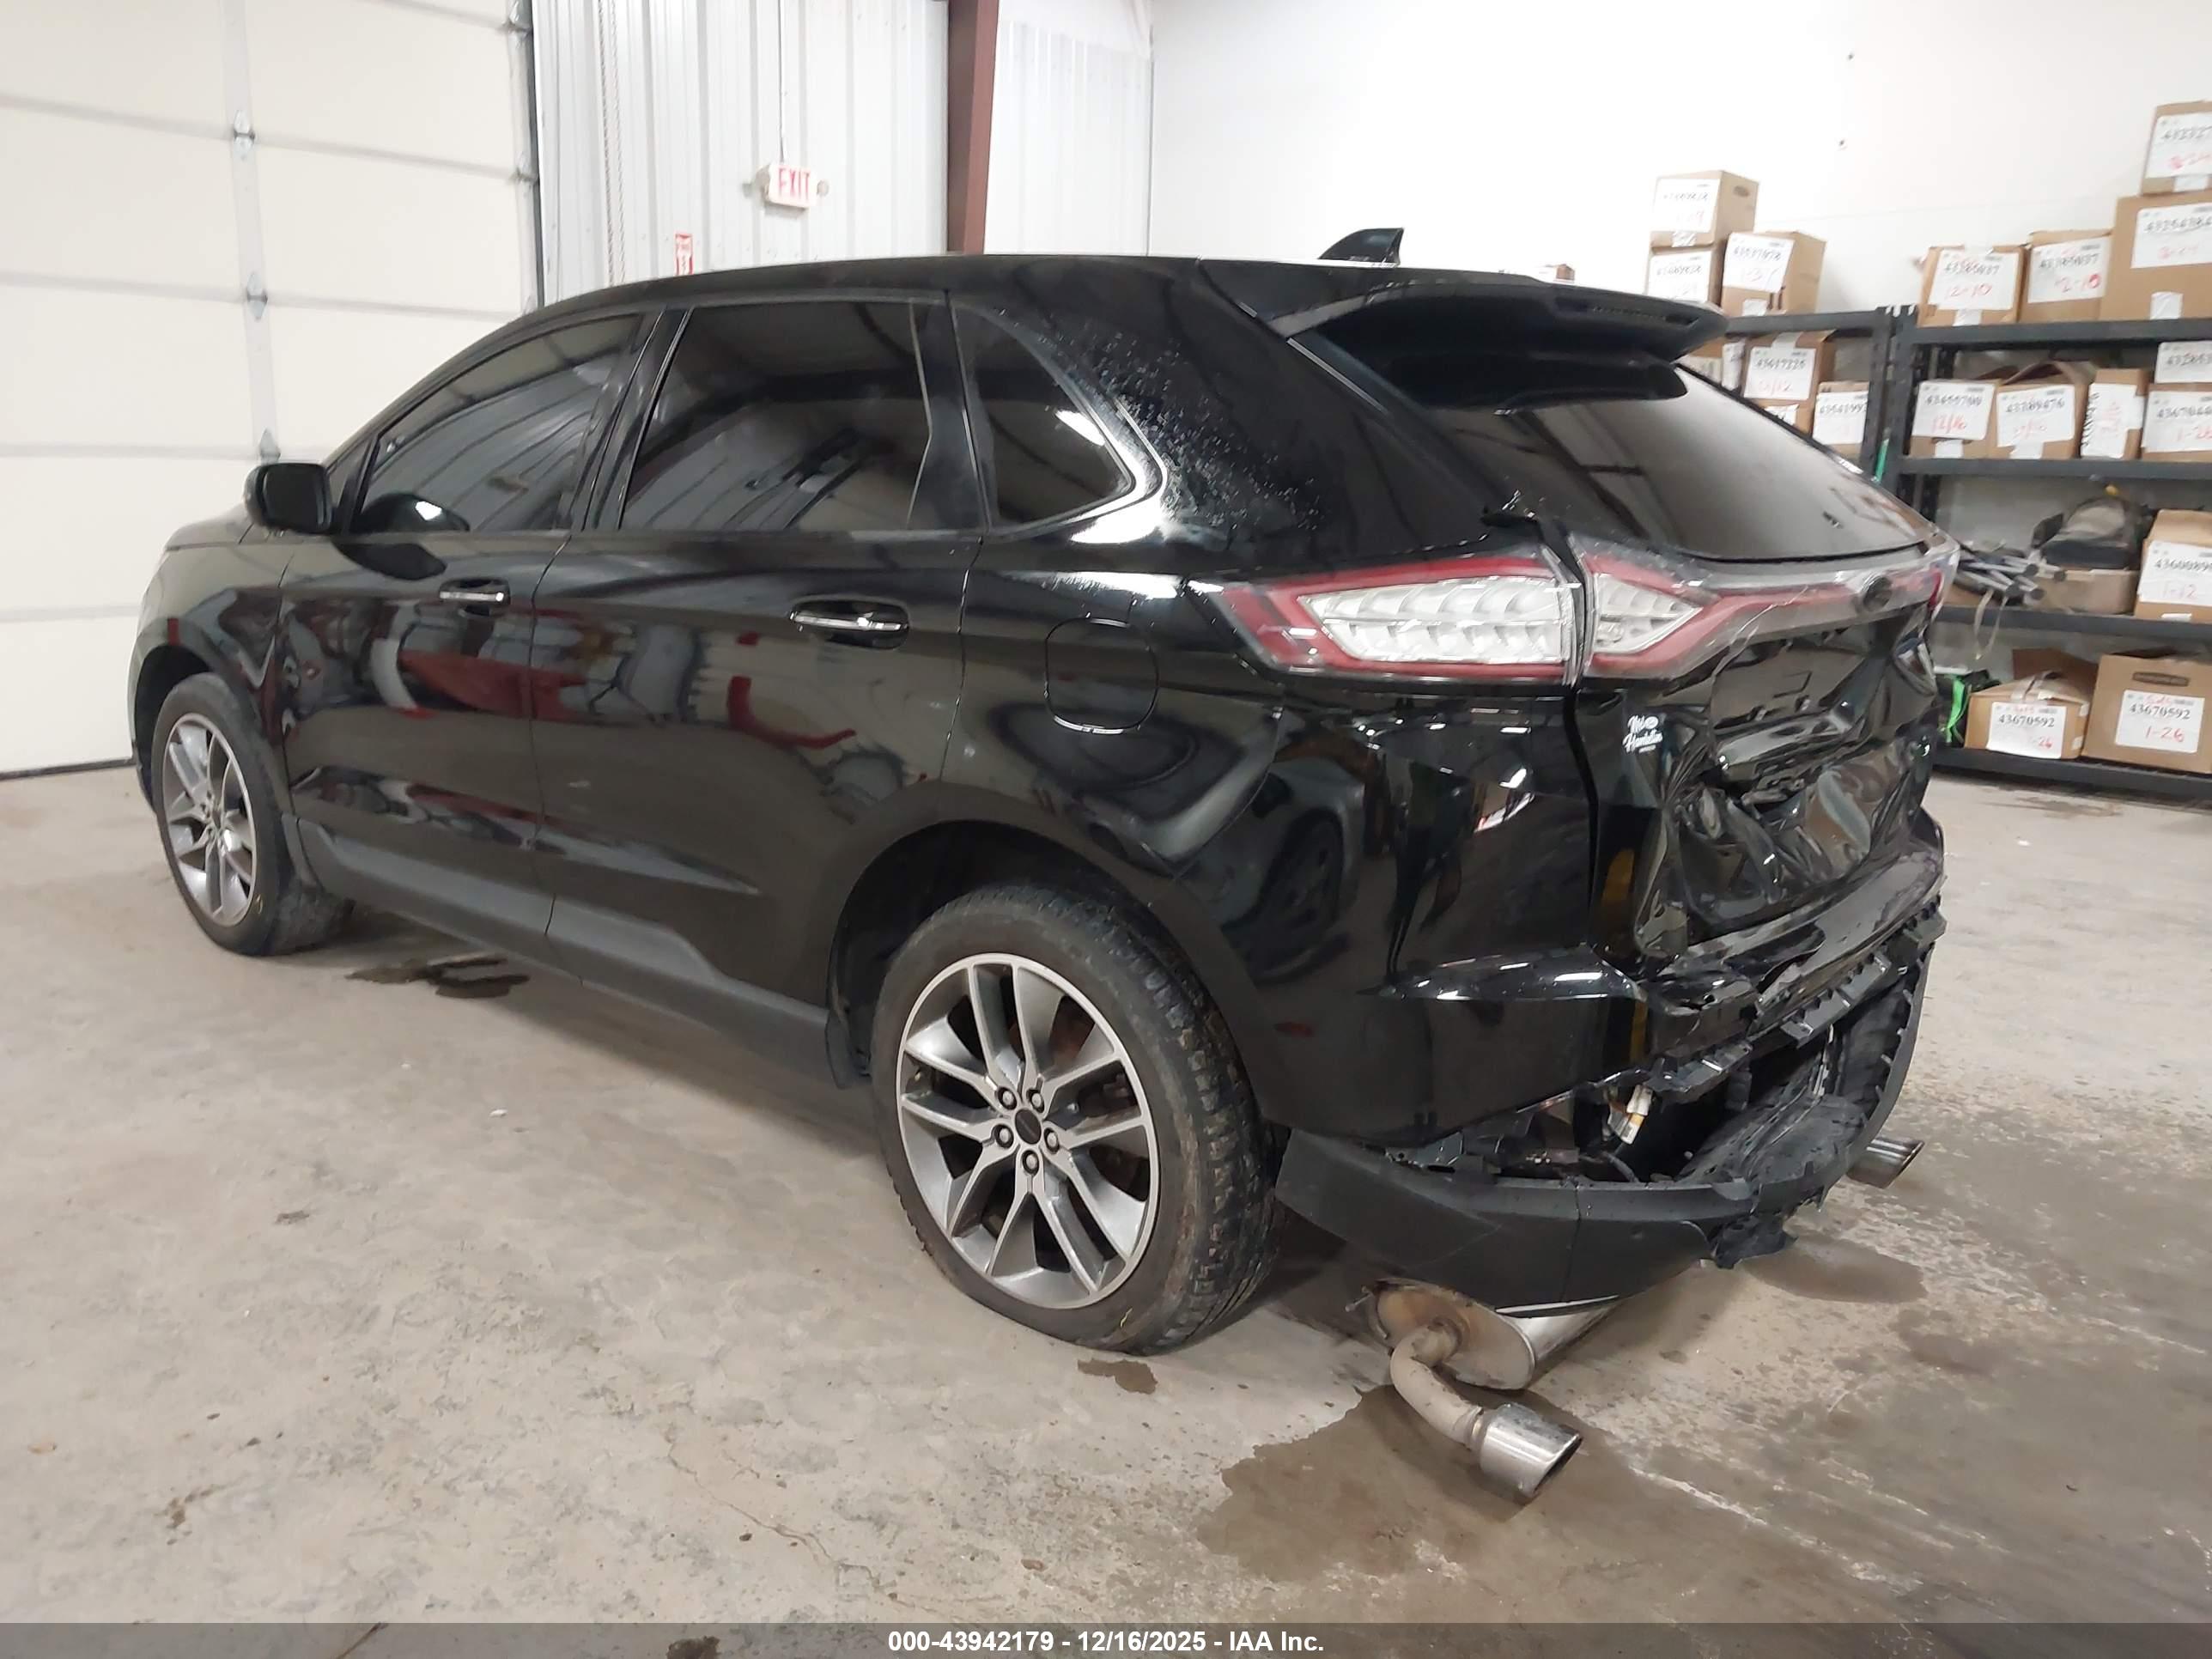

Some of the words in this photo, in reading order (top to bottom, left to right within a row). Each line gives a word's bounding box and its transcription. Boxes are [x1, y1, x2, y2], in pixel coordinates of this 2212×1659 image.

[778, 167, 811, 202] EXIT
[2130, 702, 2191, 720] 43670592
[1998, 714, 2055, 728] 43670592
[2146, 726, 2185, 744] 1-26
